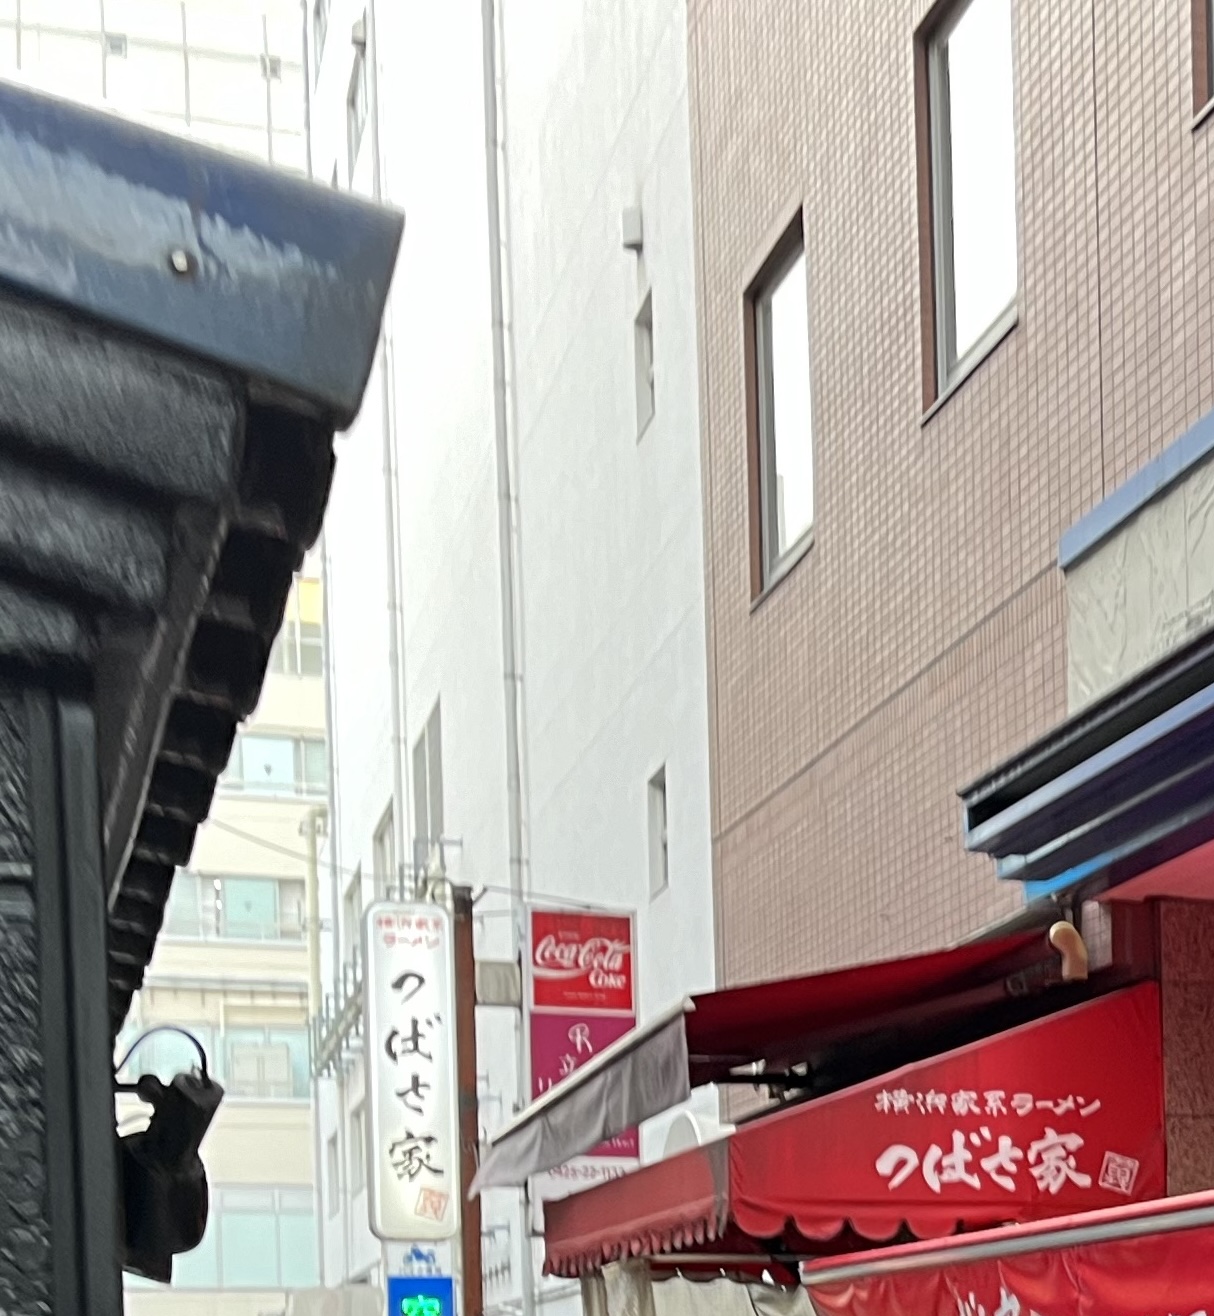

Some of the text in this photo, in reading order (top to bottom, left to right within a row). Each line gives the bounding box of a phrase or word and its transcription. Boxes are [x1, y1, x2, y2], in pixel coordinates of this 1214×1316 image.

[588, 968, 626, 989] Coke
[384, 969, 444, 1182] つばさ家
[874, 1088, 1101, 1117] 横浜家系ラーメン
[874, 1125, 1092, 1196] つばさ家
